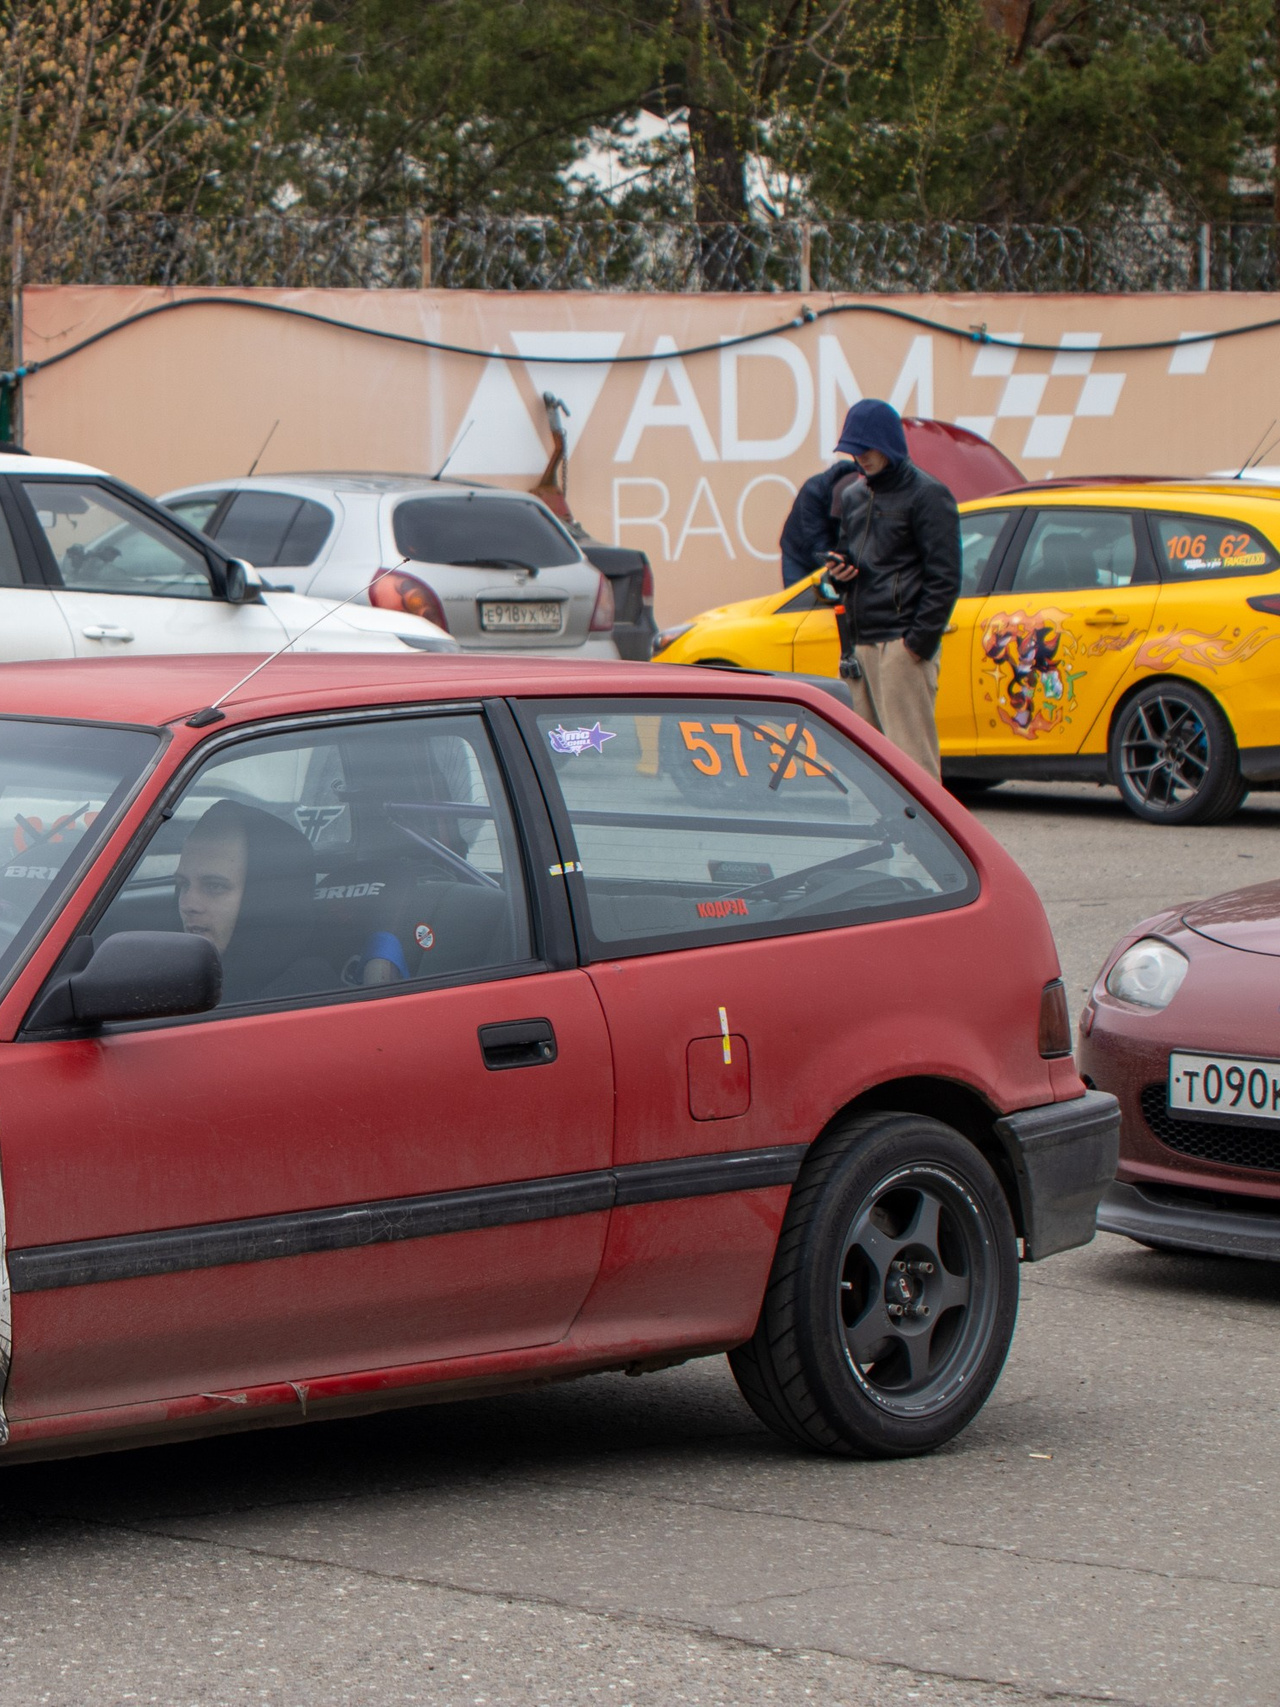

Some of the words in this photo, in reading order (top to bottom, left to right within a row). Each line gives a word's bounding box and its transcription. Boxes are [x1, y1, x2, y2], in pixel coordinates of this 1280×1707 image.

[614, 334, 933, 462] ADM
[613, 474, 798, 561] RAC
[1167, 534, 1207, 559] 106
[1220, 534, 1251, 558] 62
[678, 721, 749, 777] 57
[4, 865, 60, 880] BRI
